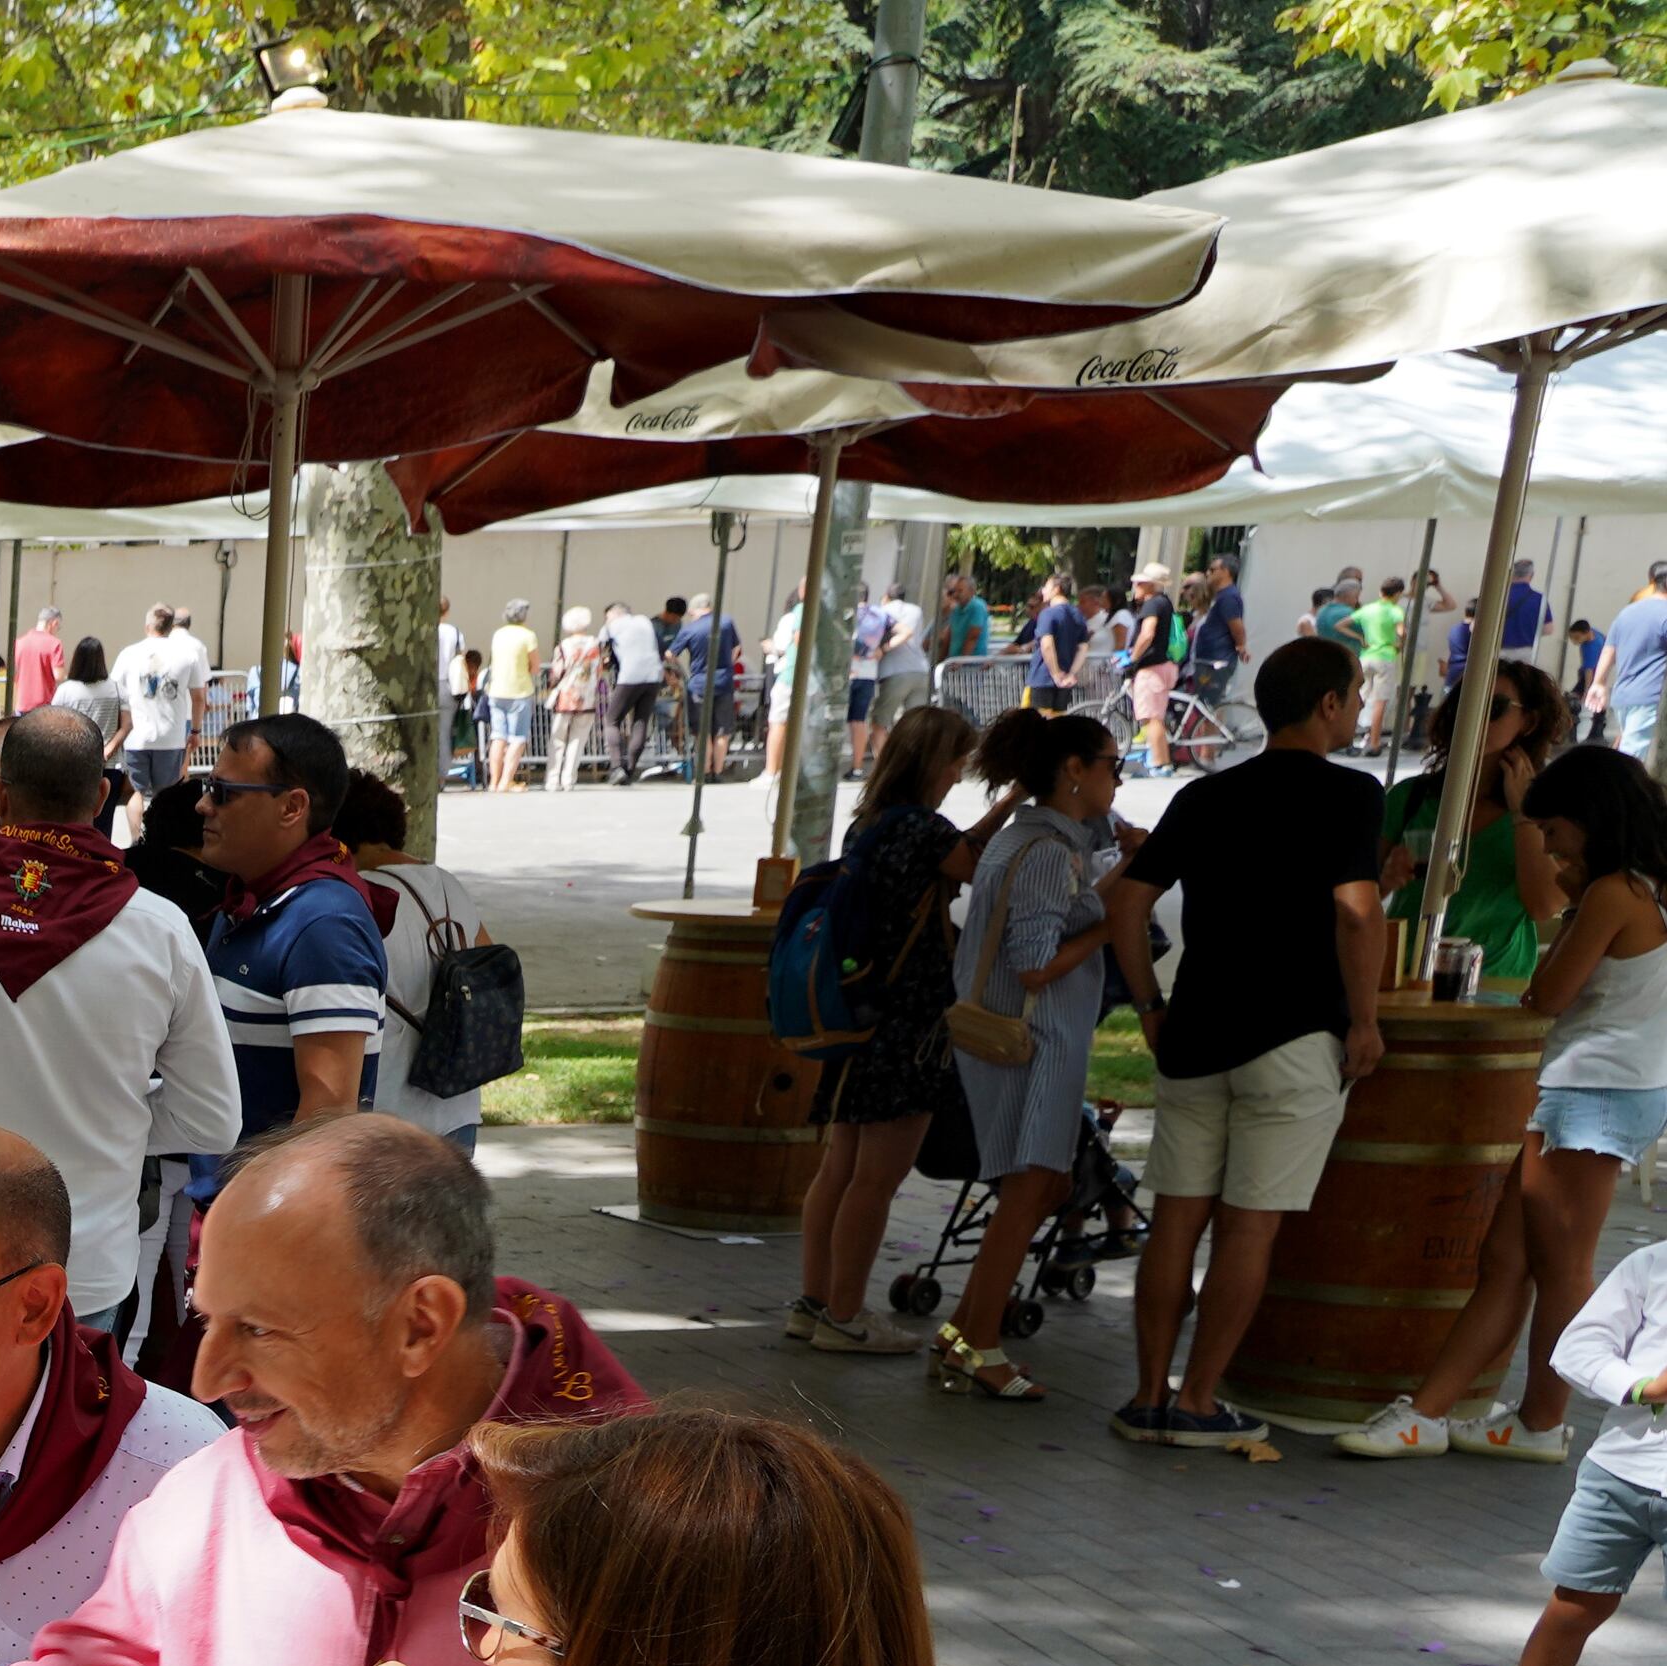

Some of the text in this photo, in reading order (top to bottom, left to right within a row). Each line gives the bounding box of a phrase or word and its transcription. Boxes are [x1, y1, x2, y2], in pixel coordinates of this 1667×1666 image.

[1076, 346, 1185, 387] Coca-Cola
[626, 403, 700, 433] Coca-Cola
[0, 914, 39, 931] Mahou
